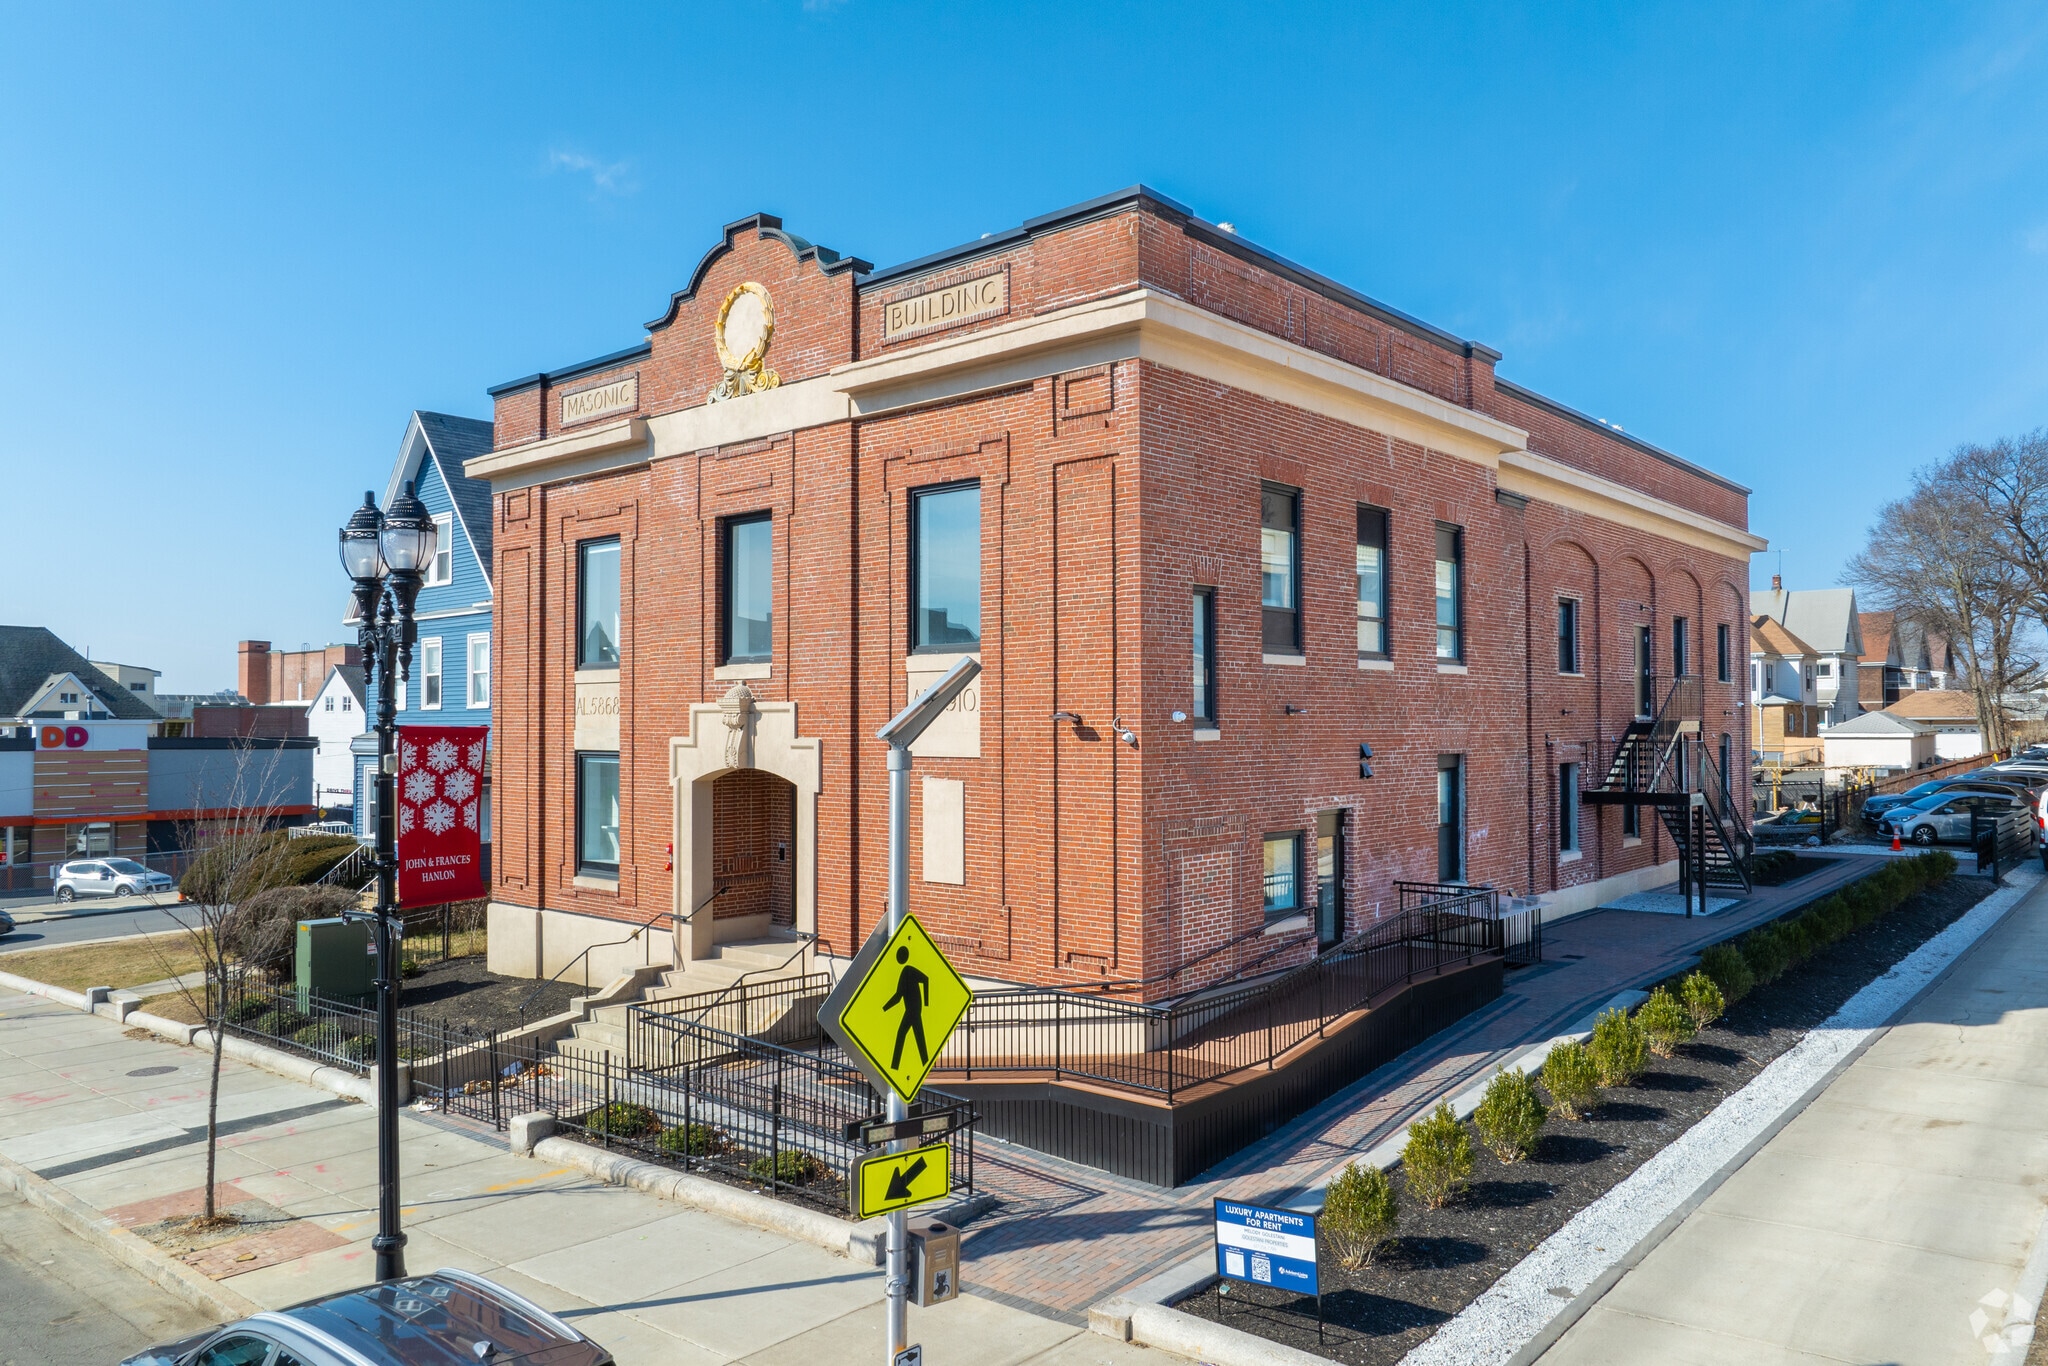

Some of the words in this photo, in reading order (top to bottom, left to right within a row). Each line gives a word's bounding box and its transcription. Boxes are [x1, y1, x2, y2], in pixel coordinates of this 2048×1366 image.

[892, 281, 997, 331] BUILDING
[567, 384, 630, 418] MASONIC
[41, 725, 89, 749] DD
[405, 857, 427, 872] JOHN
[428, 857, 435, 867] &
[435, 854, 471, 867] FRANCES
[422, 869, 456, 883] HANLON
[1225, 1205, 1253, 1217] LUXURY
[1254, 1210, 1304, 1227] APARTMENTS
[1246, 1217, 1262, 1228] FOR
[1263, 1220, 1283, 1231] RENT
